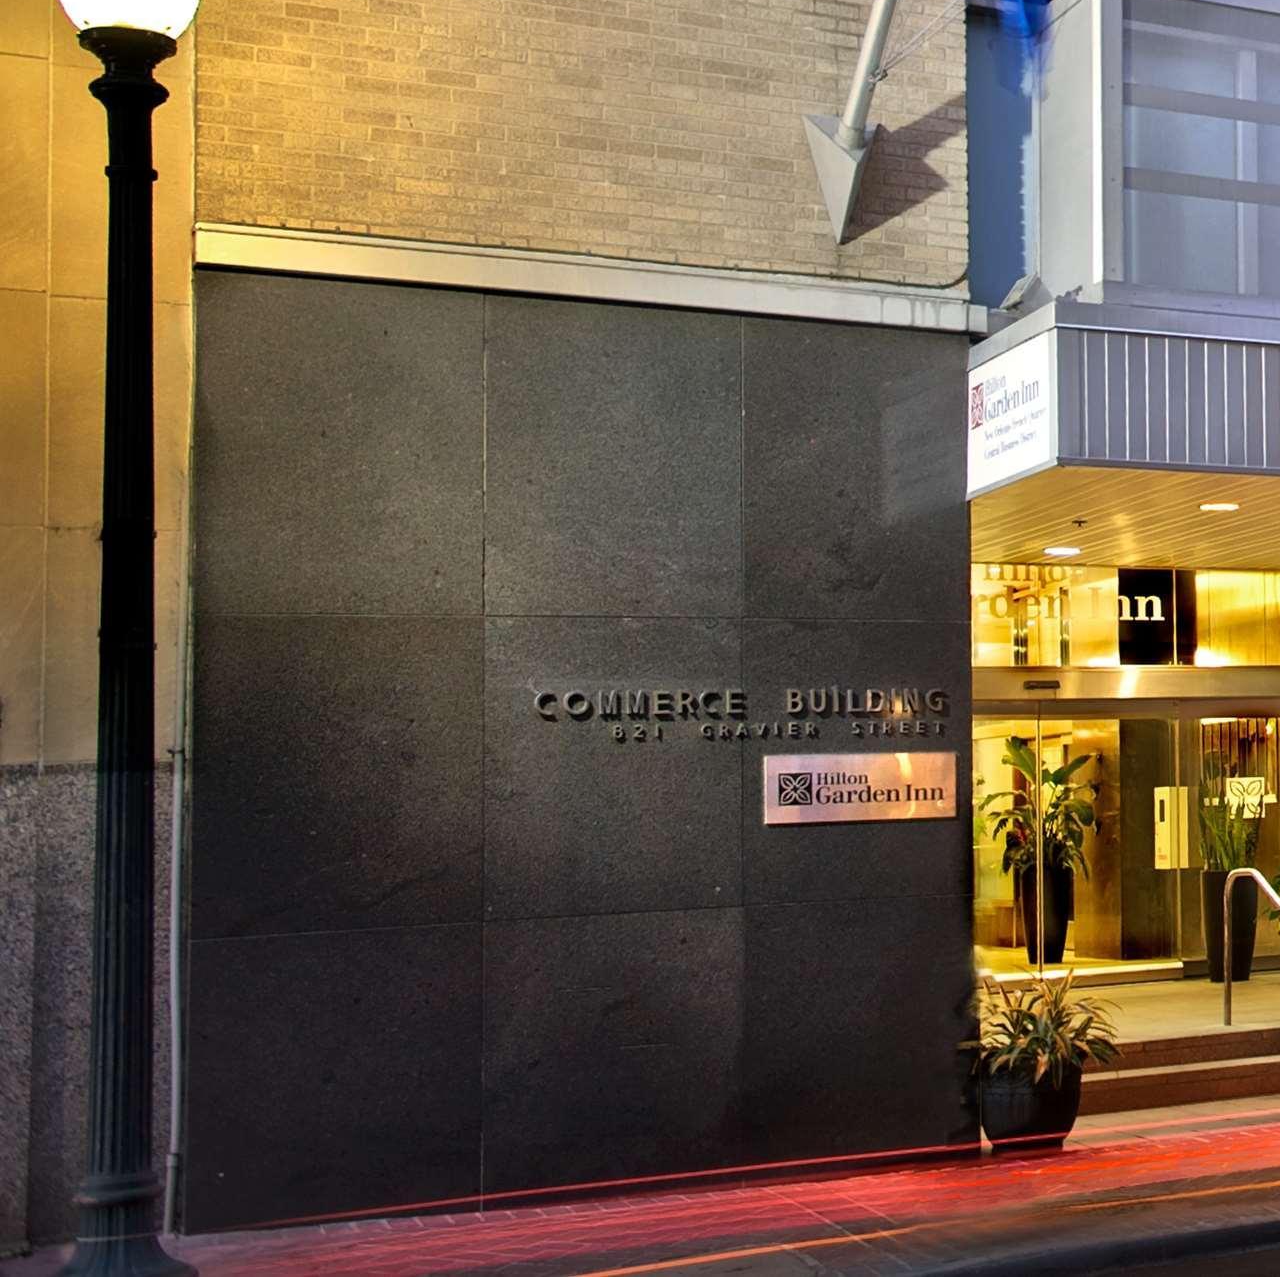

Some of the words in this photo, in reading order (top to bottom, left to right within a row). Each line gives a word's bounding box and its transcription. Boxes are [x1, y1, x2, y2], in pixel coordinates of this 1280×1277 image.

[534, 689, 750, 717] COMMERCE
[786, 687, 945, 713] BUILDING
[612, 723, 664, 739] 821
[700, 723, 818, 738] GRAVIER
[851, 722, 943, 735] STREET
[817, 772, 869, 786] Hilton
[816, 784, 900, 804] Garden
[905, 783, 945, 802] Inn
